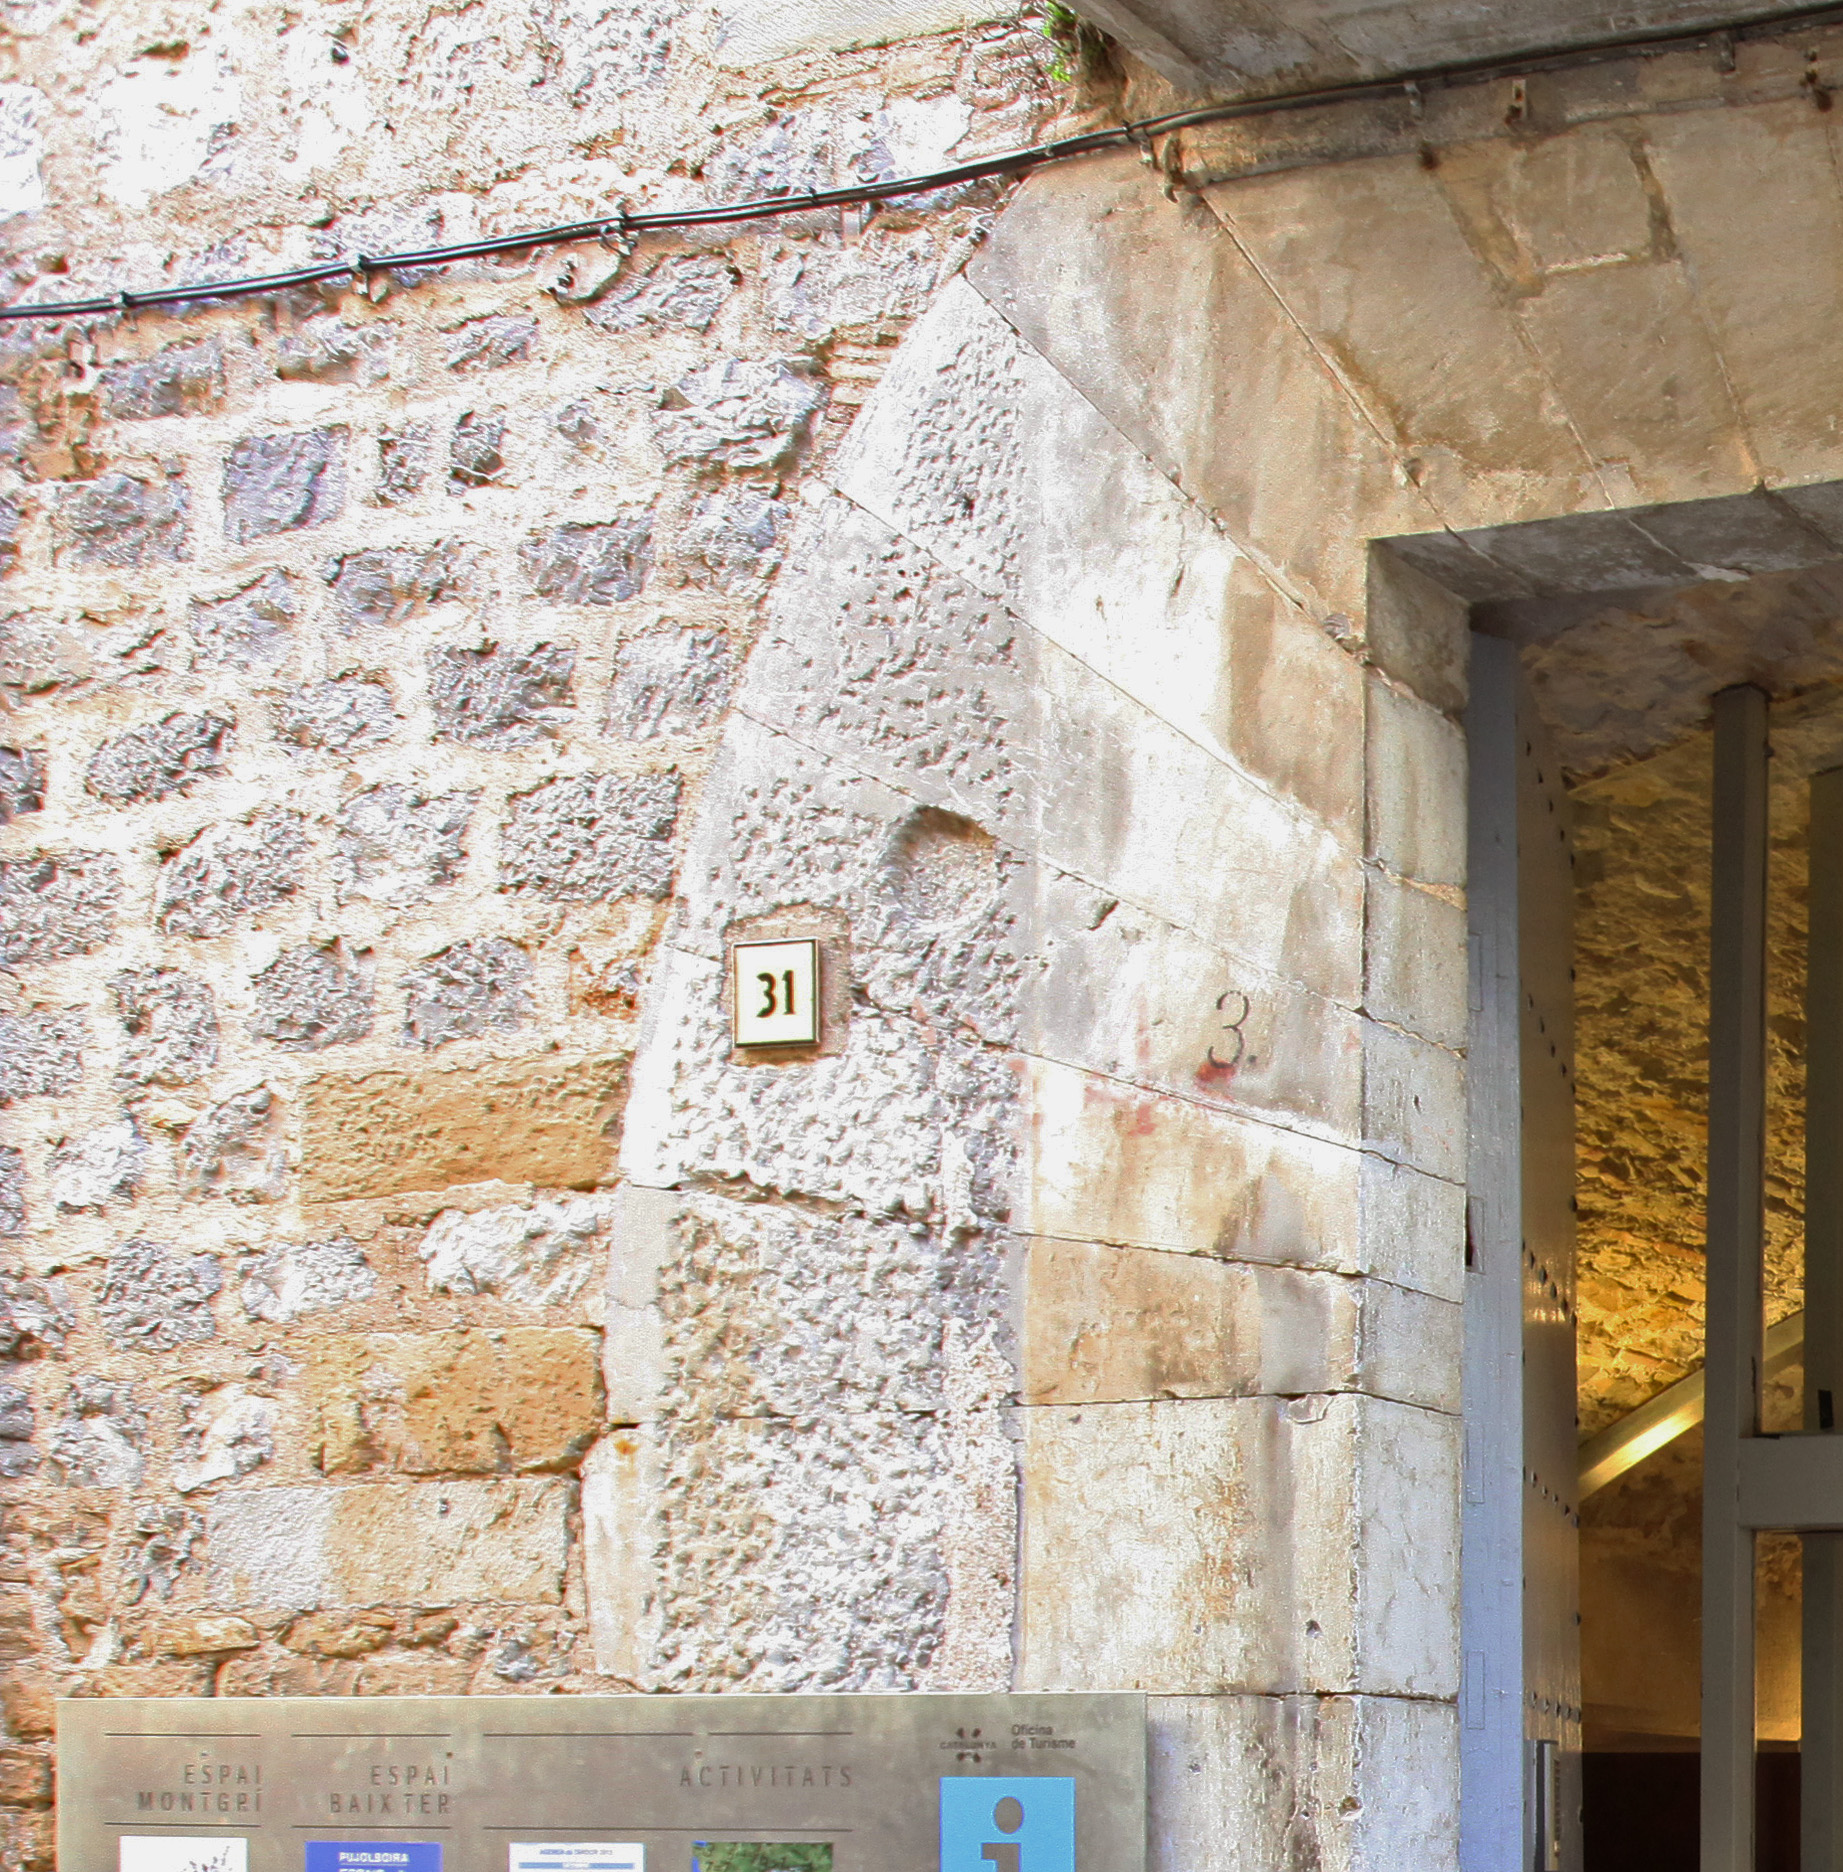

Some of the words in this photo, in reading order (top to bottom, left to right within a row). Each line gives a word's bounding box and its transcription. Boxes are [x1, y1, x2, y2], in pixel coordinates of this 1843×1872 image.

[756, 969, 796, 1018] 31
[1011, 1724, 1053, 1736] Oficina
[1011, 1738, 1026, 1750] de
[1029, 1738, 1076, 1750] Turisme
[184, 1765, 262, 1785] ESPAI
[371, 1765, 450, 1786] ESPAI
[680, 1765, 851, 1787] ACTIVITATS
[136, 1790, 262, 1812] MONTGRÍ
[331, 1793, 392, 1814] BAIX
[403, 1793, 451, 1815] TER
